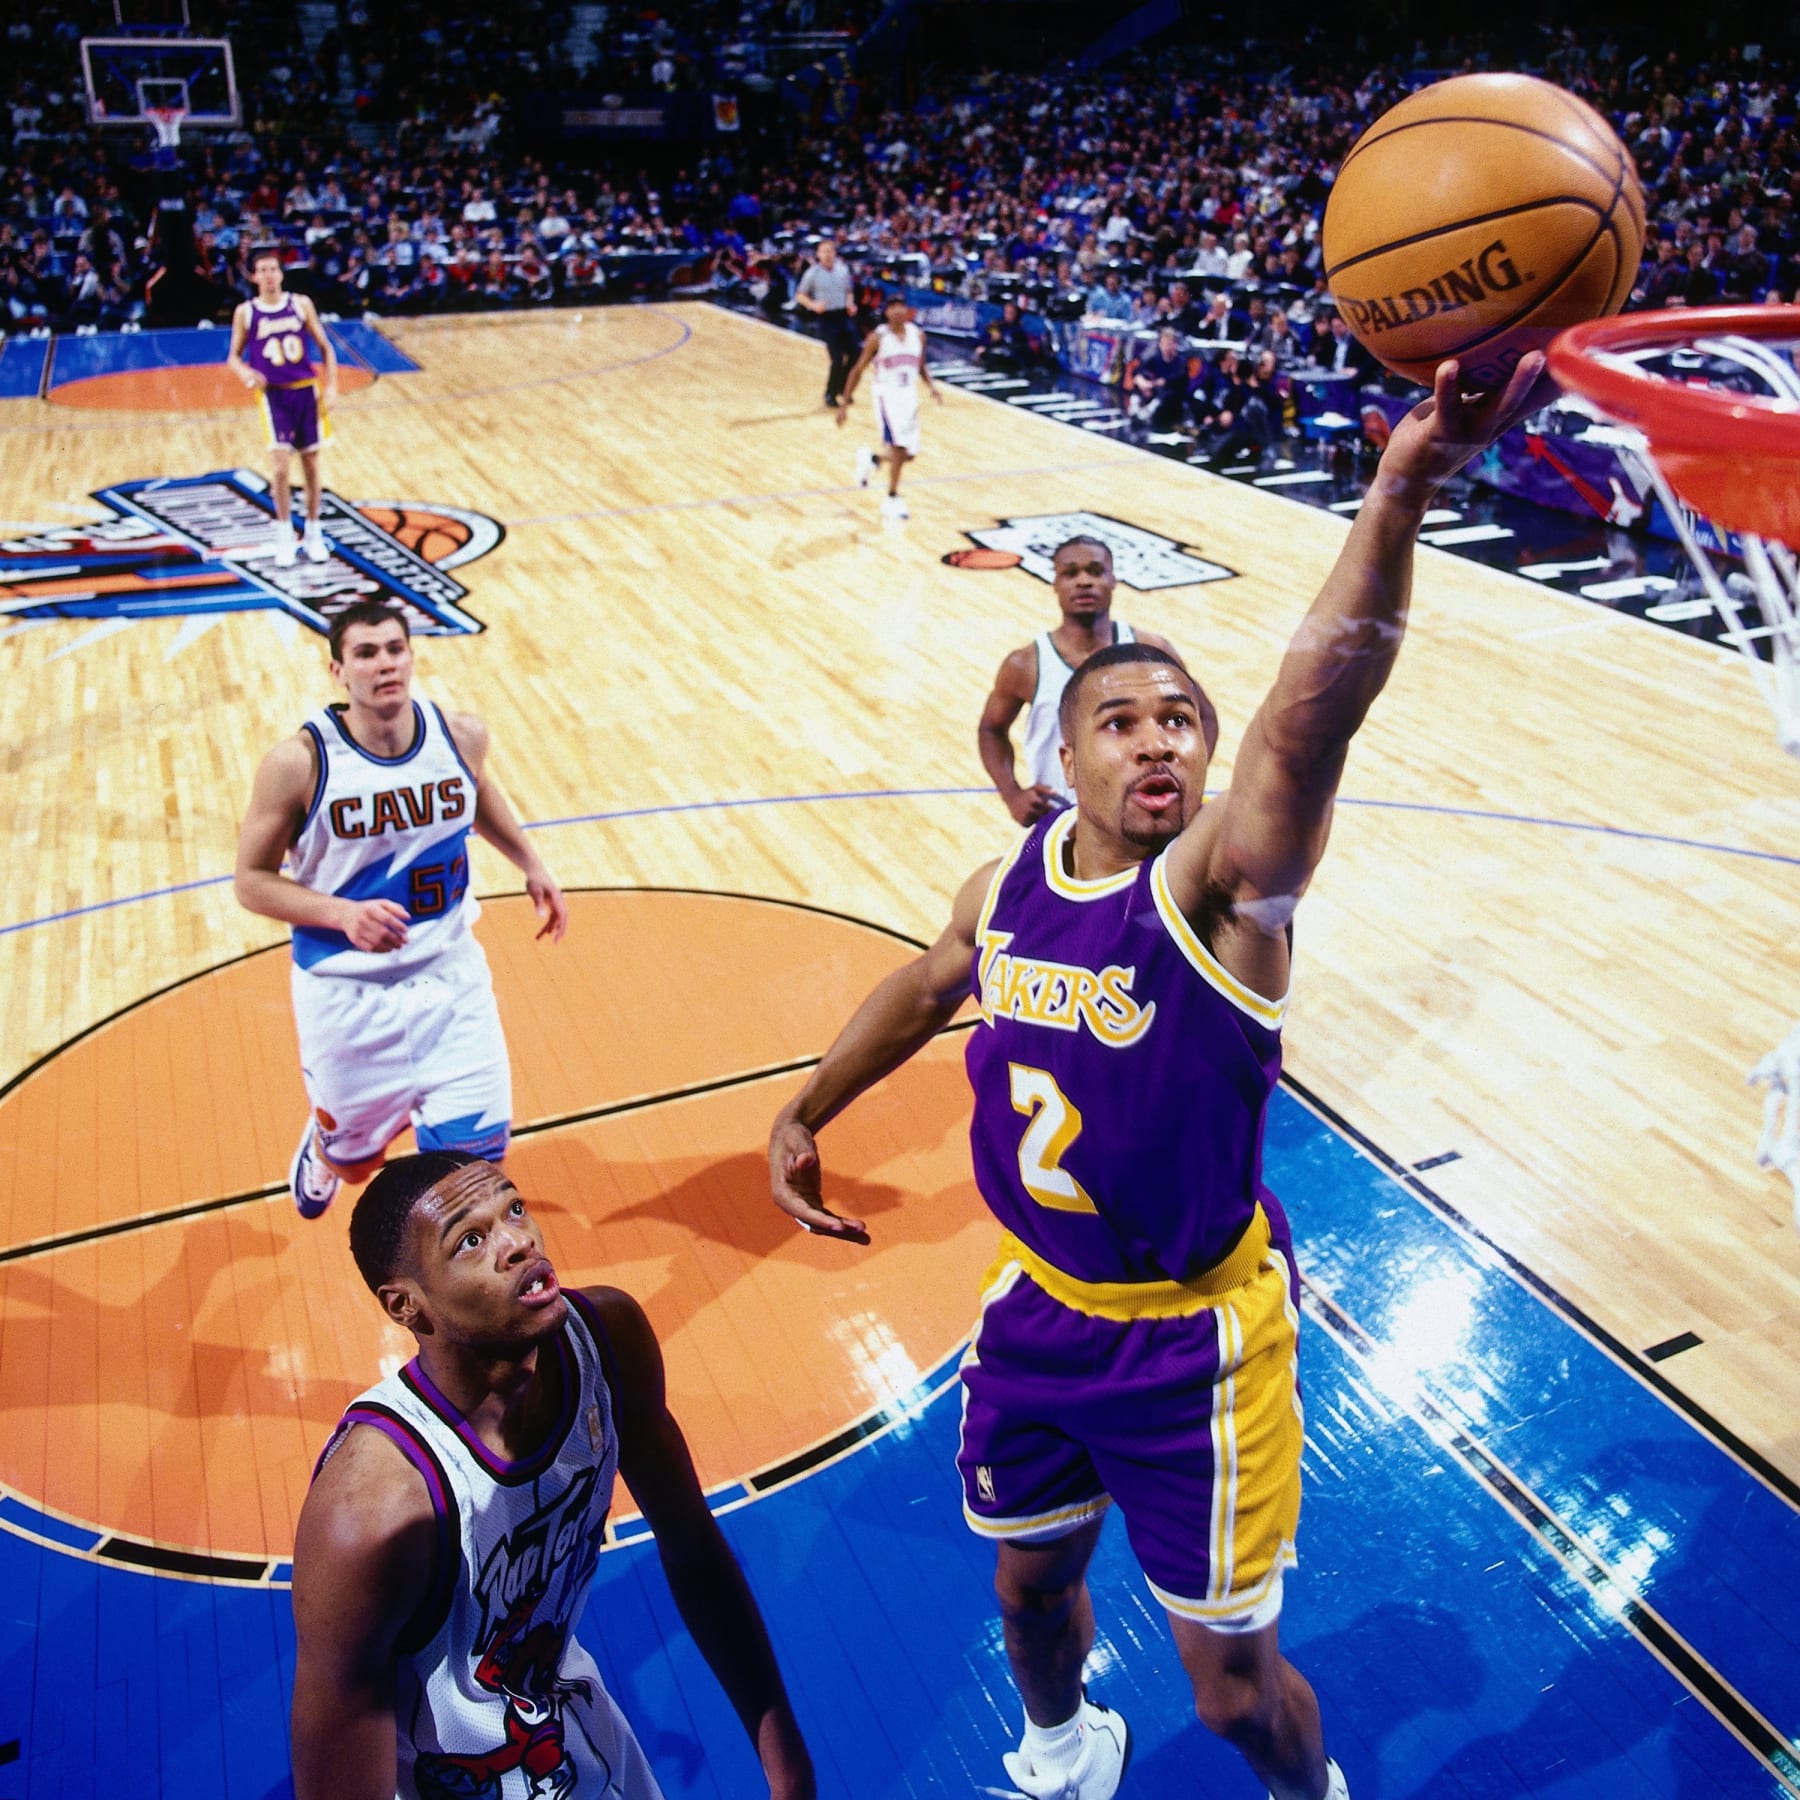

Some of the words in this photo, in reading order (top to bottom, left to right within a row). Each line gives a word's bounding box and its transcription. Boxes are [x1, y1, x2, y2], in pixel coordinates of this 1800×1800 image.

[1338, 240, 1522, 336] PALDING
[262, 334, 304, 366] 40
[329, 777, 466, 839] CAVS
[977, 929, 1156, 1048] LAKERS
[1008, 1061, 1099, 1215] 2
